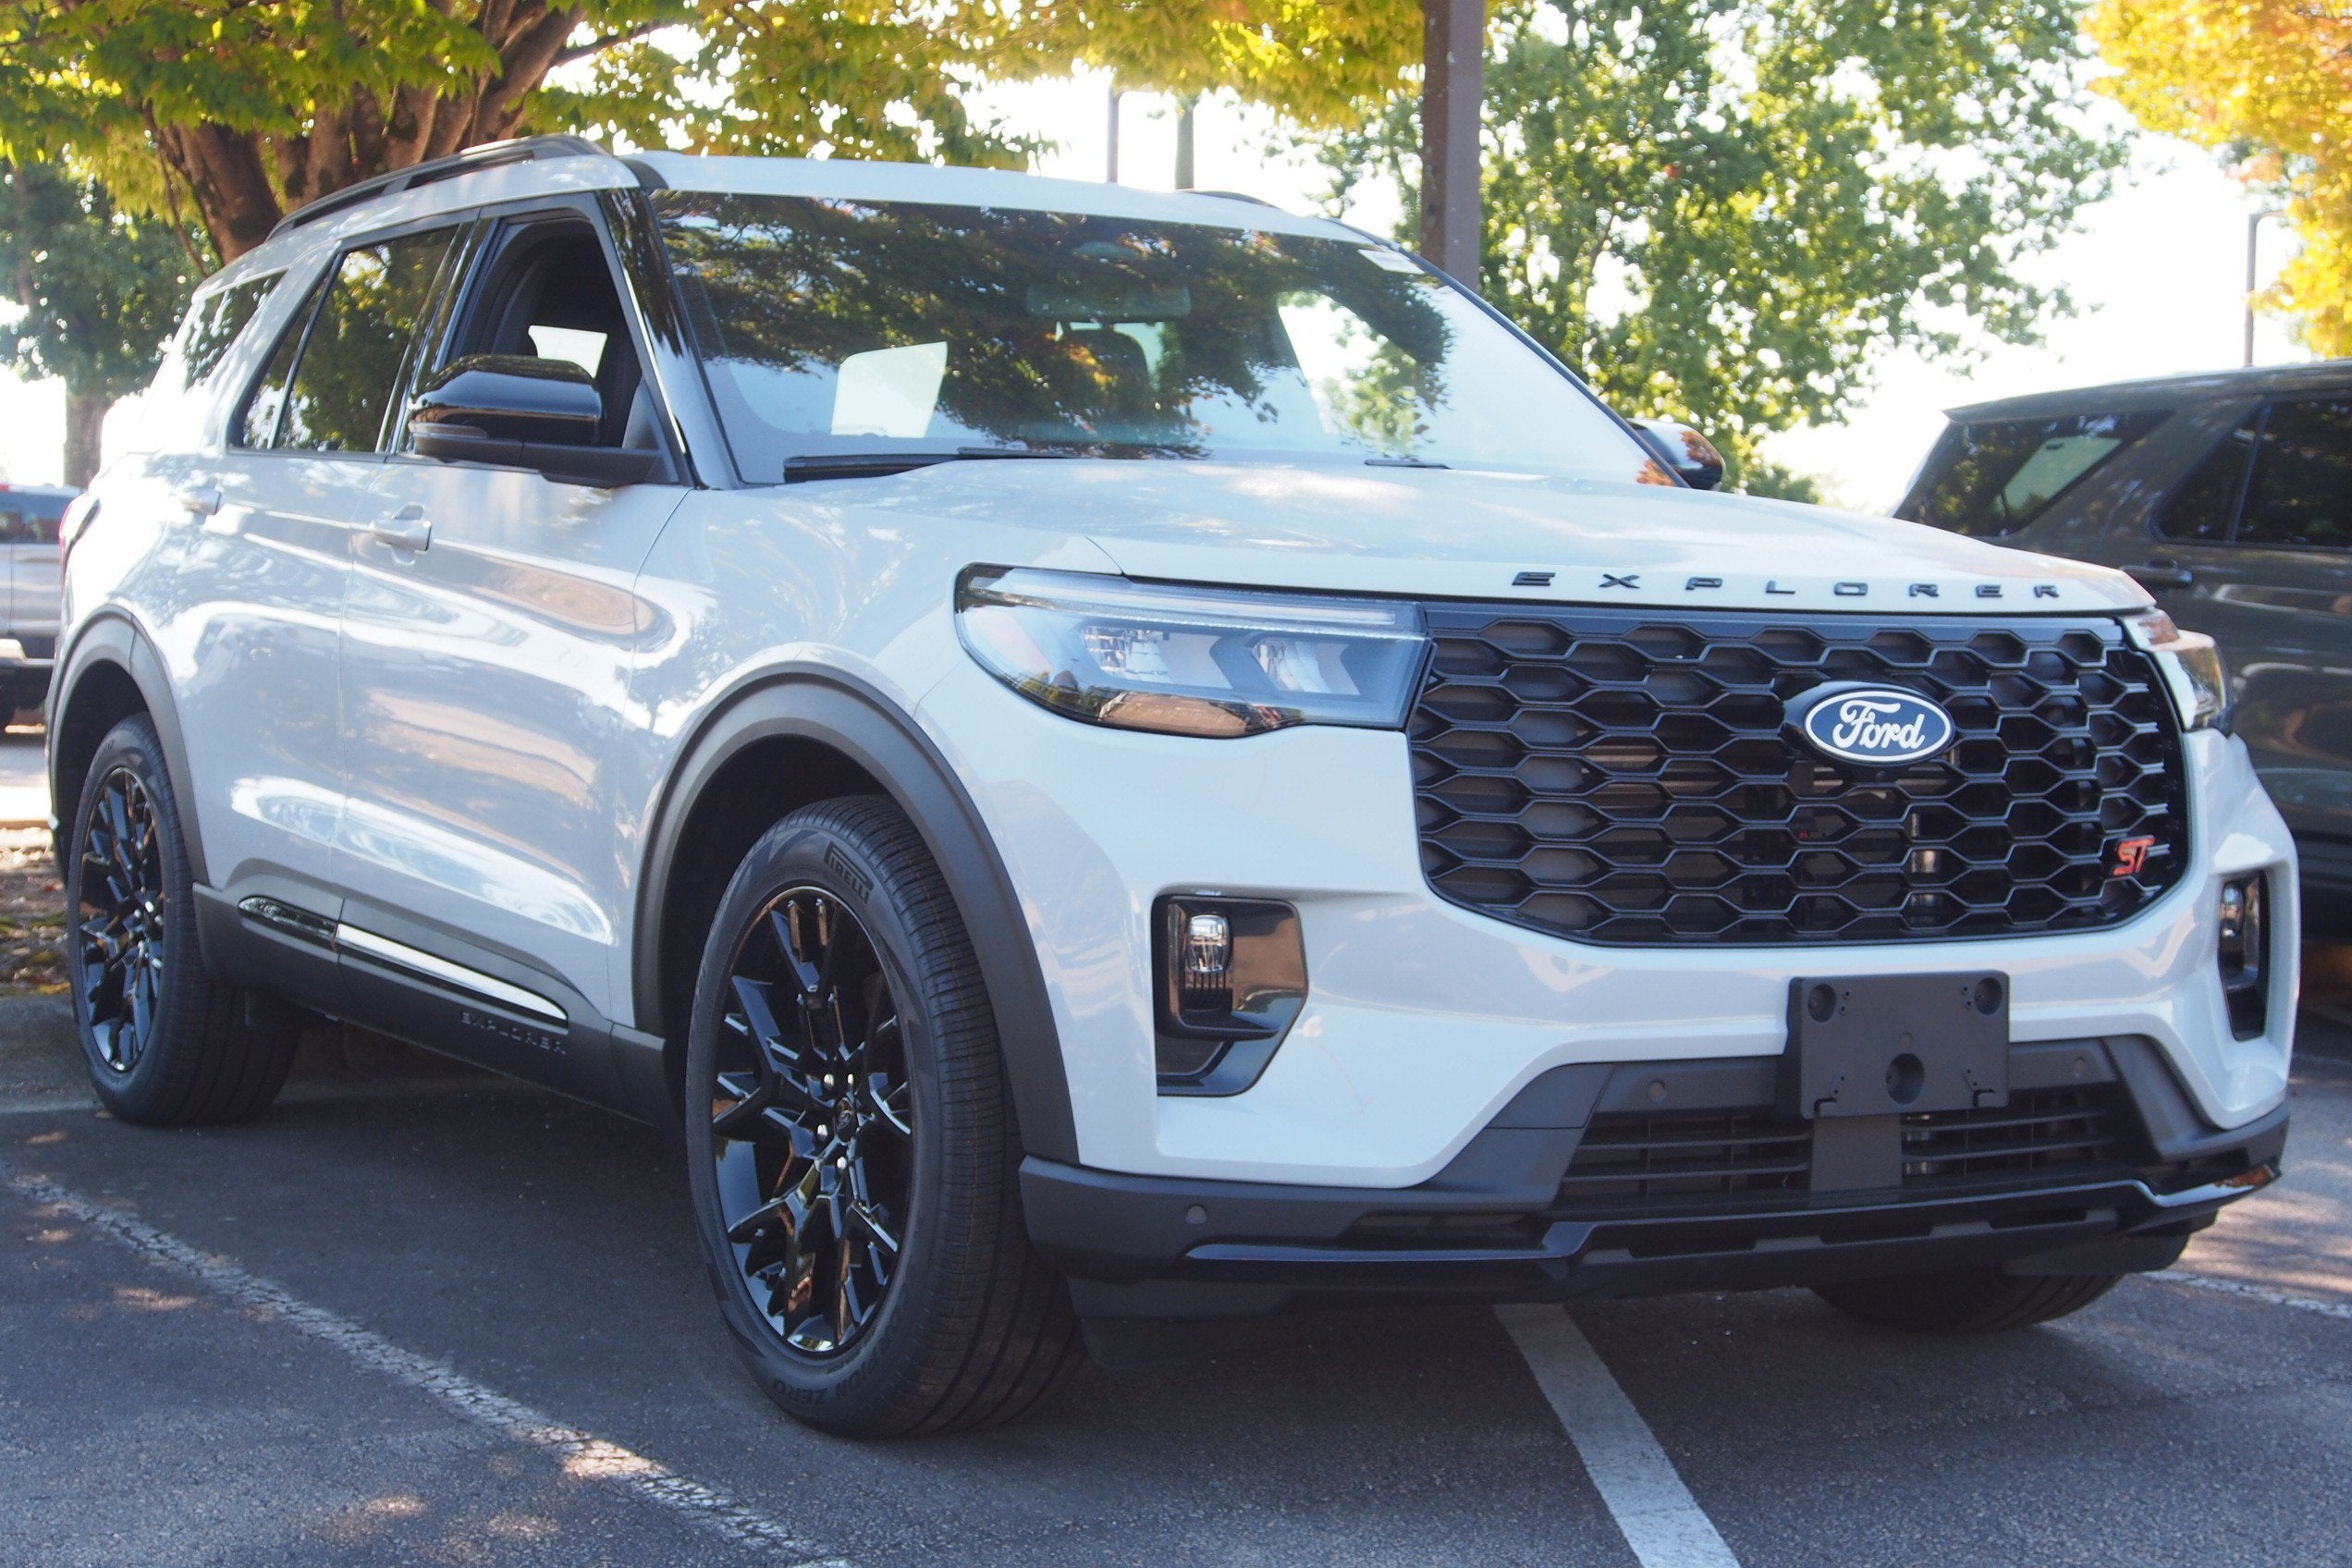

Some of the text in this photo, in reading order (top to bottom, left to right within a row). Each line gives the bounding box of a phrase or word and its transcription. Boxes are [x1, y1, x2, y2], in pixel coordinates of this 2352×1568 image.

[1511, 571, 2060, 598] EXPLORER
[1832, 699, 1926, 749] Ford
[823, 840, 874, 904] PIRELLI
[2113, 837, 2155, 876] ST
